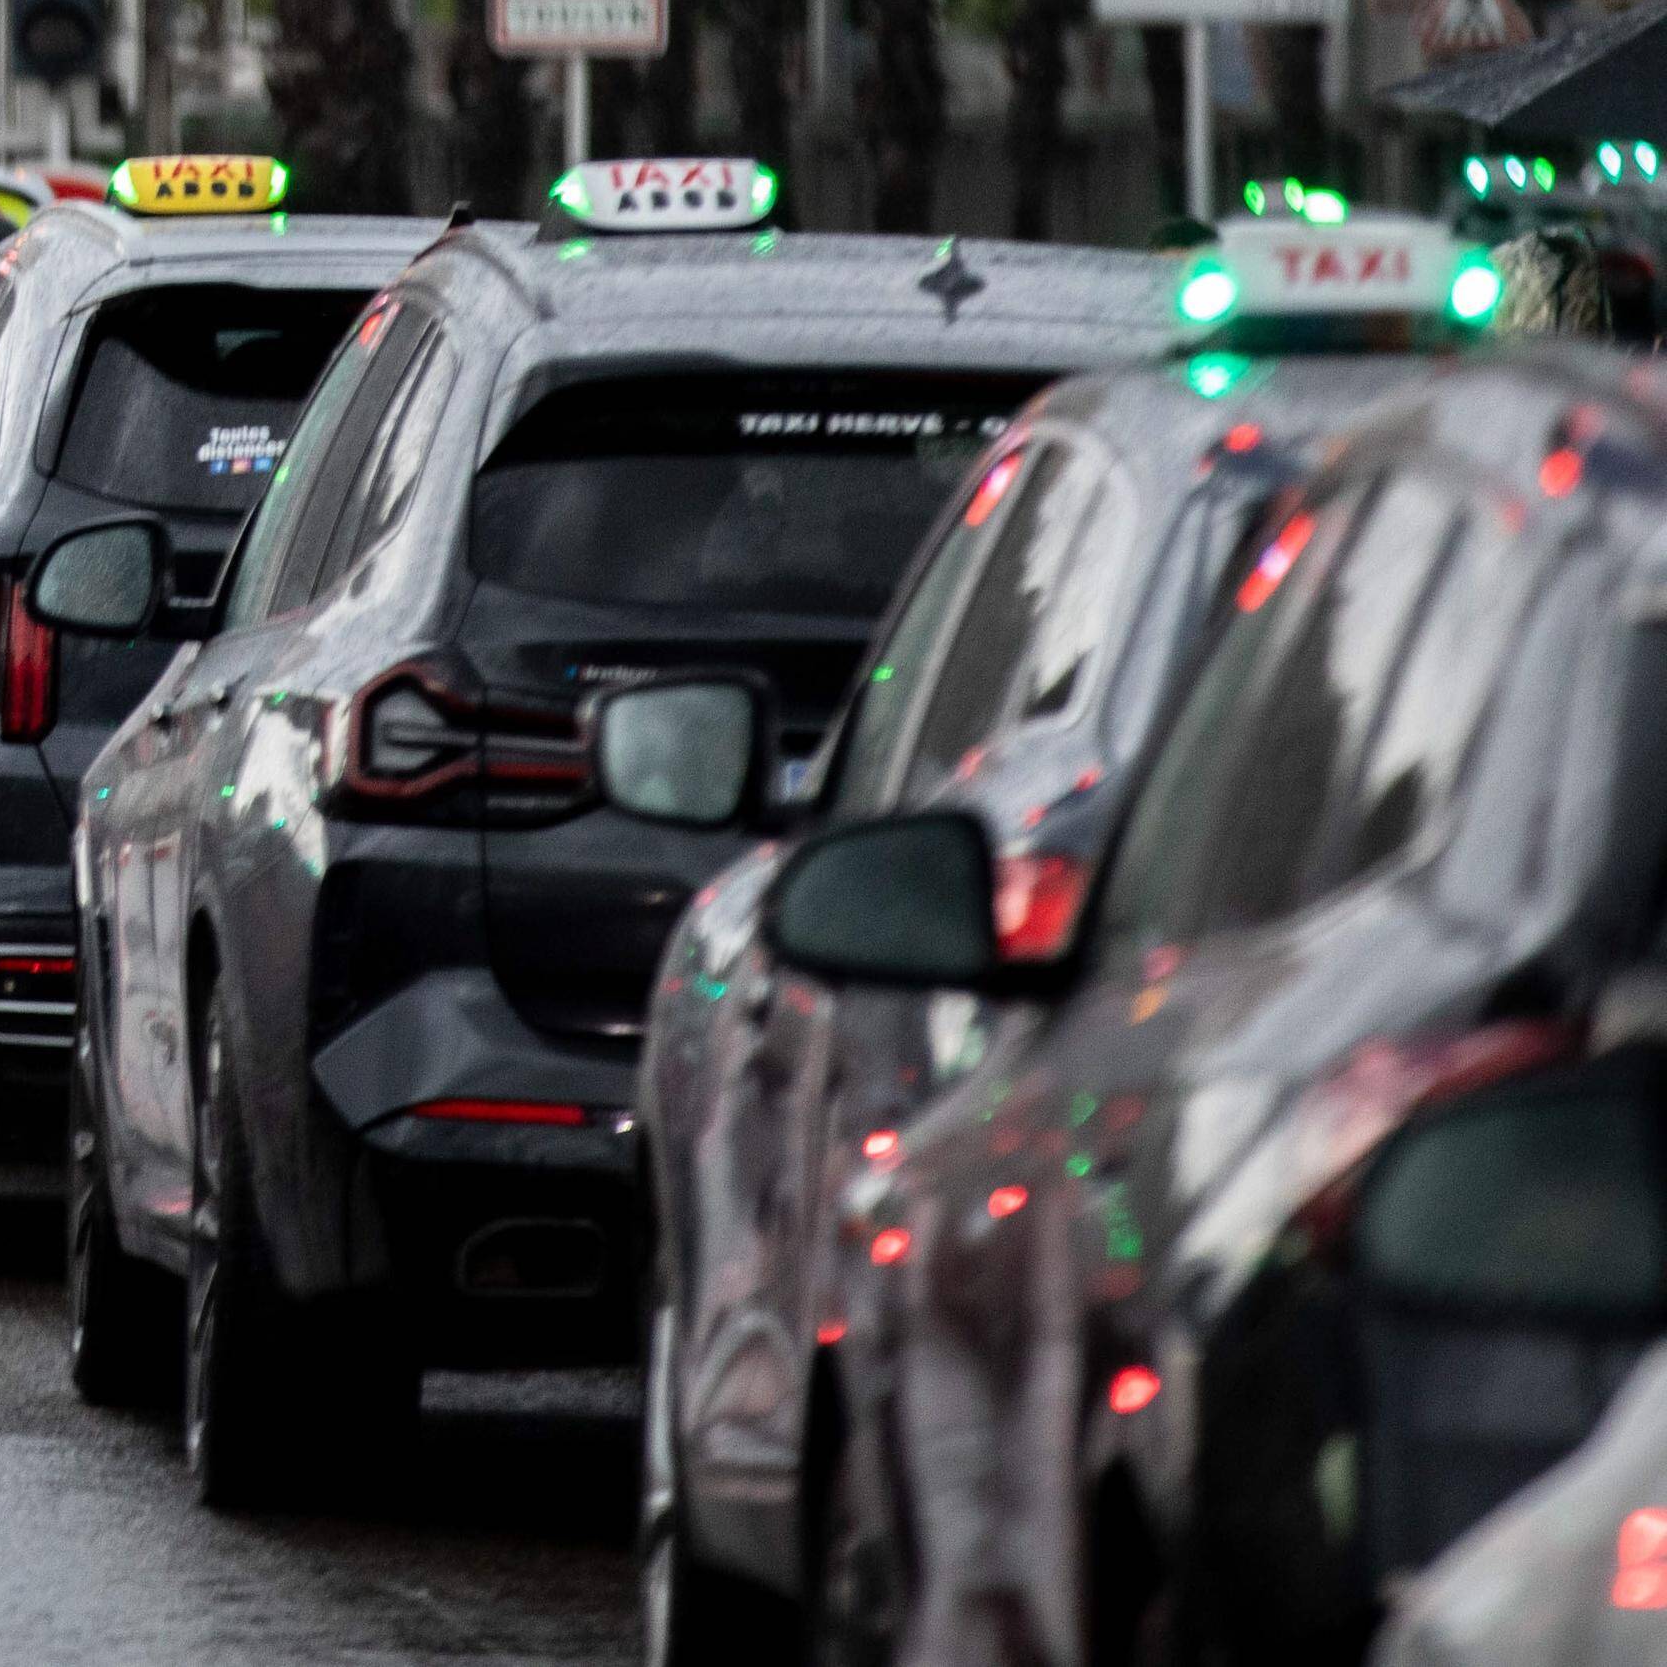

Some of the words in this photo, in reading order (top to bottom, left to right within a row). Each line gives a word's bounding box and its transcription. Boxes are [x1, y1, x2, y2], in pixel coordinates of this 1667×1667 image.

[148, 156, 255, 182] TAXI
[605, 158, 733, 190] TAXI
[1273, 244, 1411, 283] TAXI
[739, 412, 820, 435] TAXI
